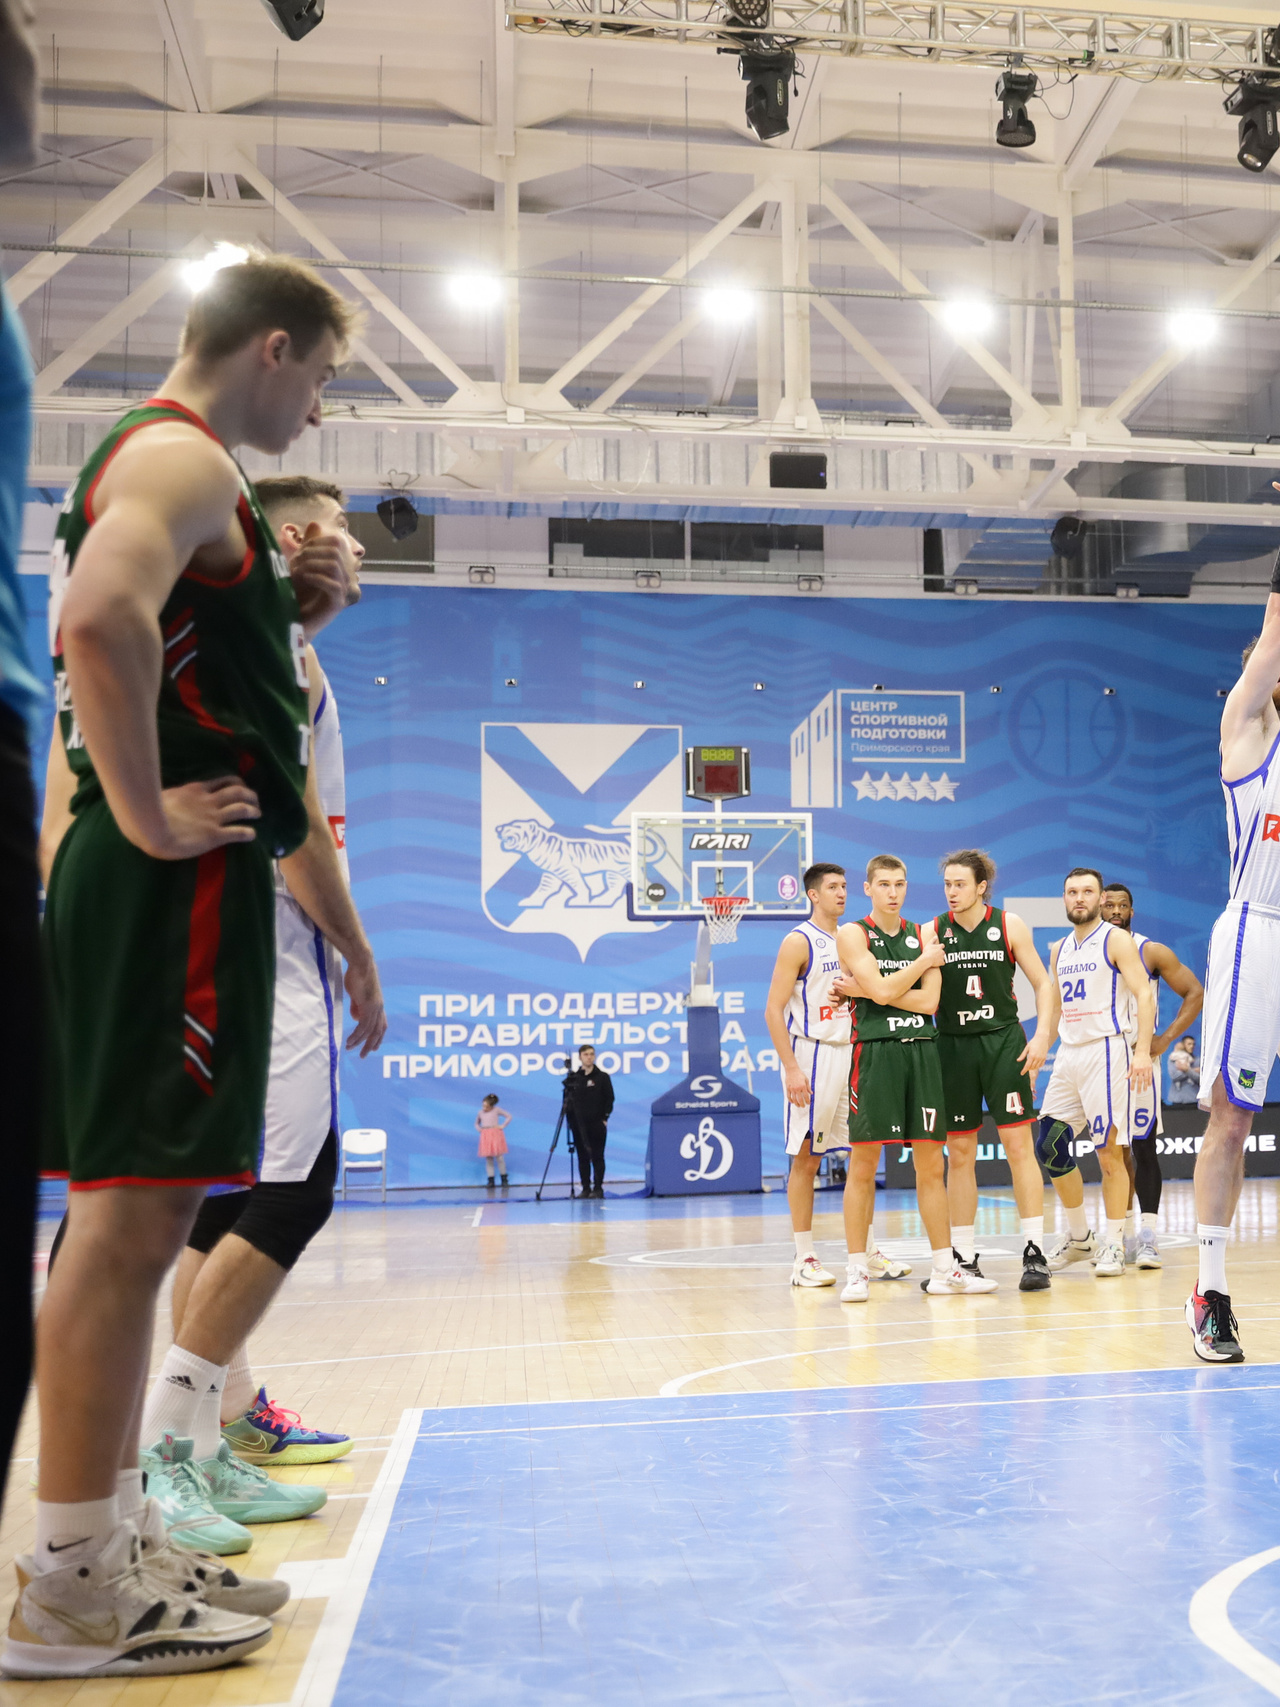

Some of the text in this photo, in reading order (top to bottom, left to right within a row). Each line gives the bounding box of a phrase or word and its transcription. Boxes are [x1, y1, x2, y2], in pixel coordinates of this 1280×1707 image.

[851, 701, 898, 713] ЦЕНТР
[851, 714, 948, 726] СПОРТИВНОЙ
[851, 728, 946, 740] ПОДГОТОВКИ
[851, 742, 924, 753] Приморского
[690, 834, 750, 849] PARI
[965, 974, 984, 1000] 4
[1062, 978, 1087, 1003] 24
[419, 993, 495, 1018] ПРИ
[418, 1021, 746, 1048] ПРАВИТЕЛЬСТА
[1005, 1091, 1025, 1115] 4
[921, 1106, 938, 1132] 17
[1134, 1108, 1149, 1128] 6
[165, 1376, 197, 1392] adidas
